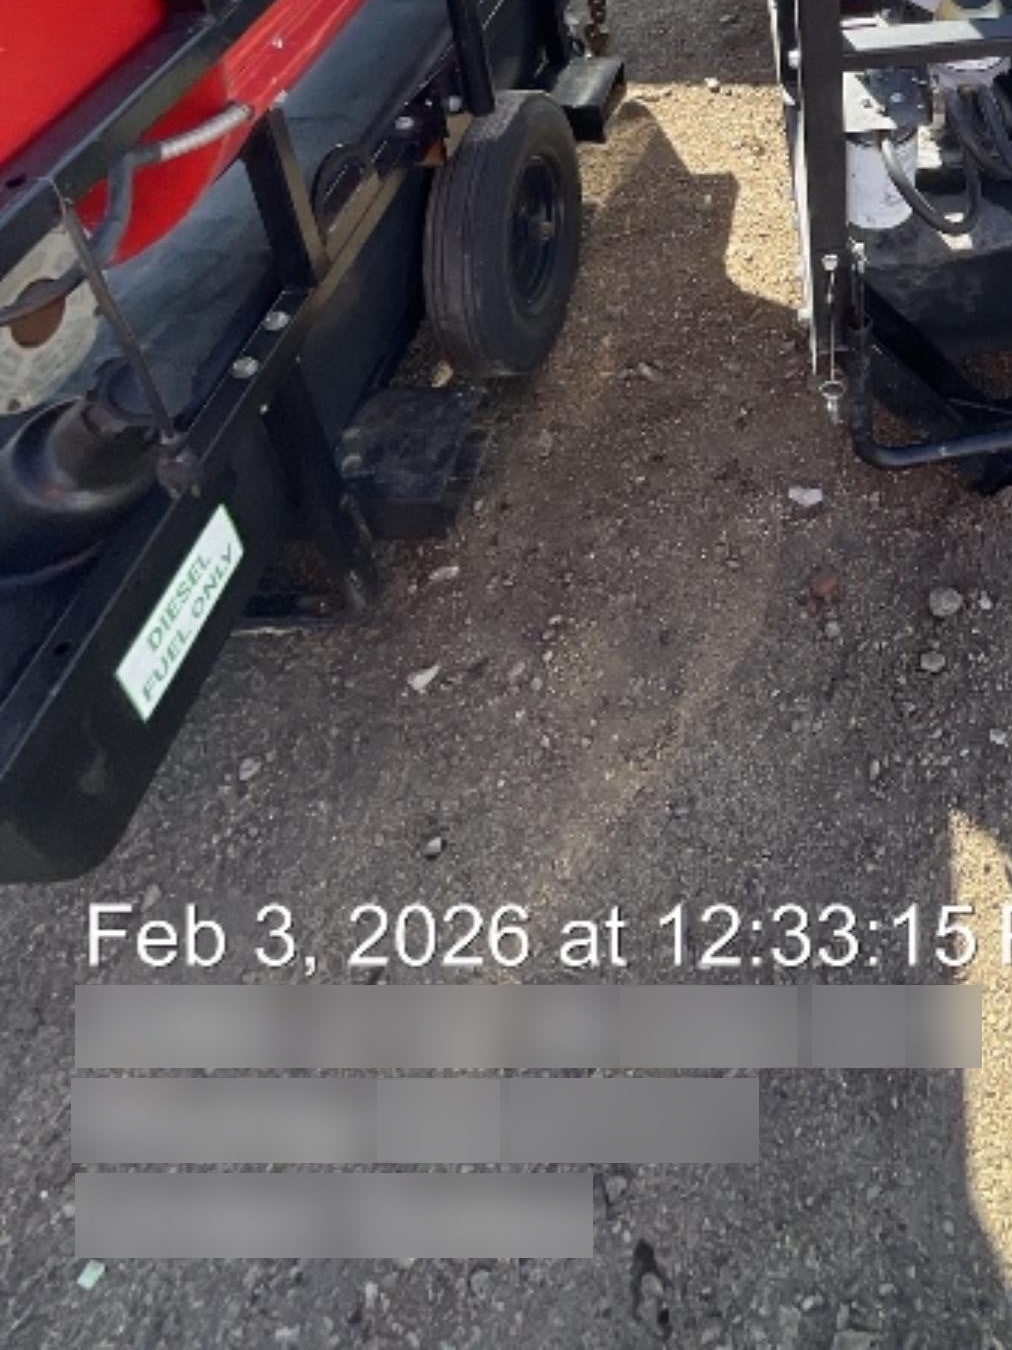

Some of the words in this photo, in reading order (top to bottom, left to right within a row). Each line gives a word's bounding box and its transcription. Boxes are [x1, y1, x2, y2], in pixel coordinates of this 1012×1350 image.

[142, 628, 193, 700] FUEL
[190, 542, 232, 618] ONLY
[147, 554, 210, 650] DIESEL
